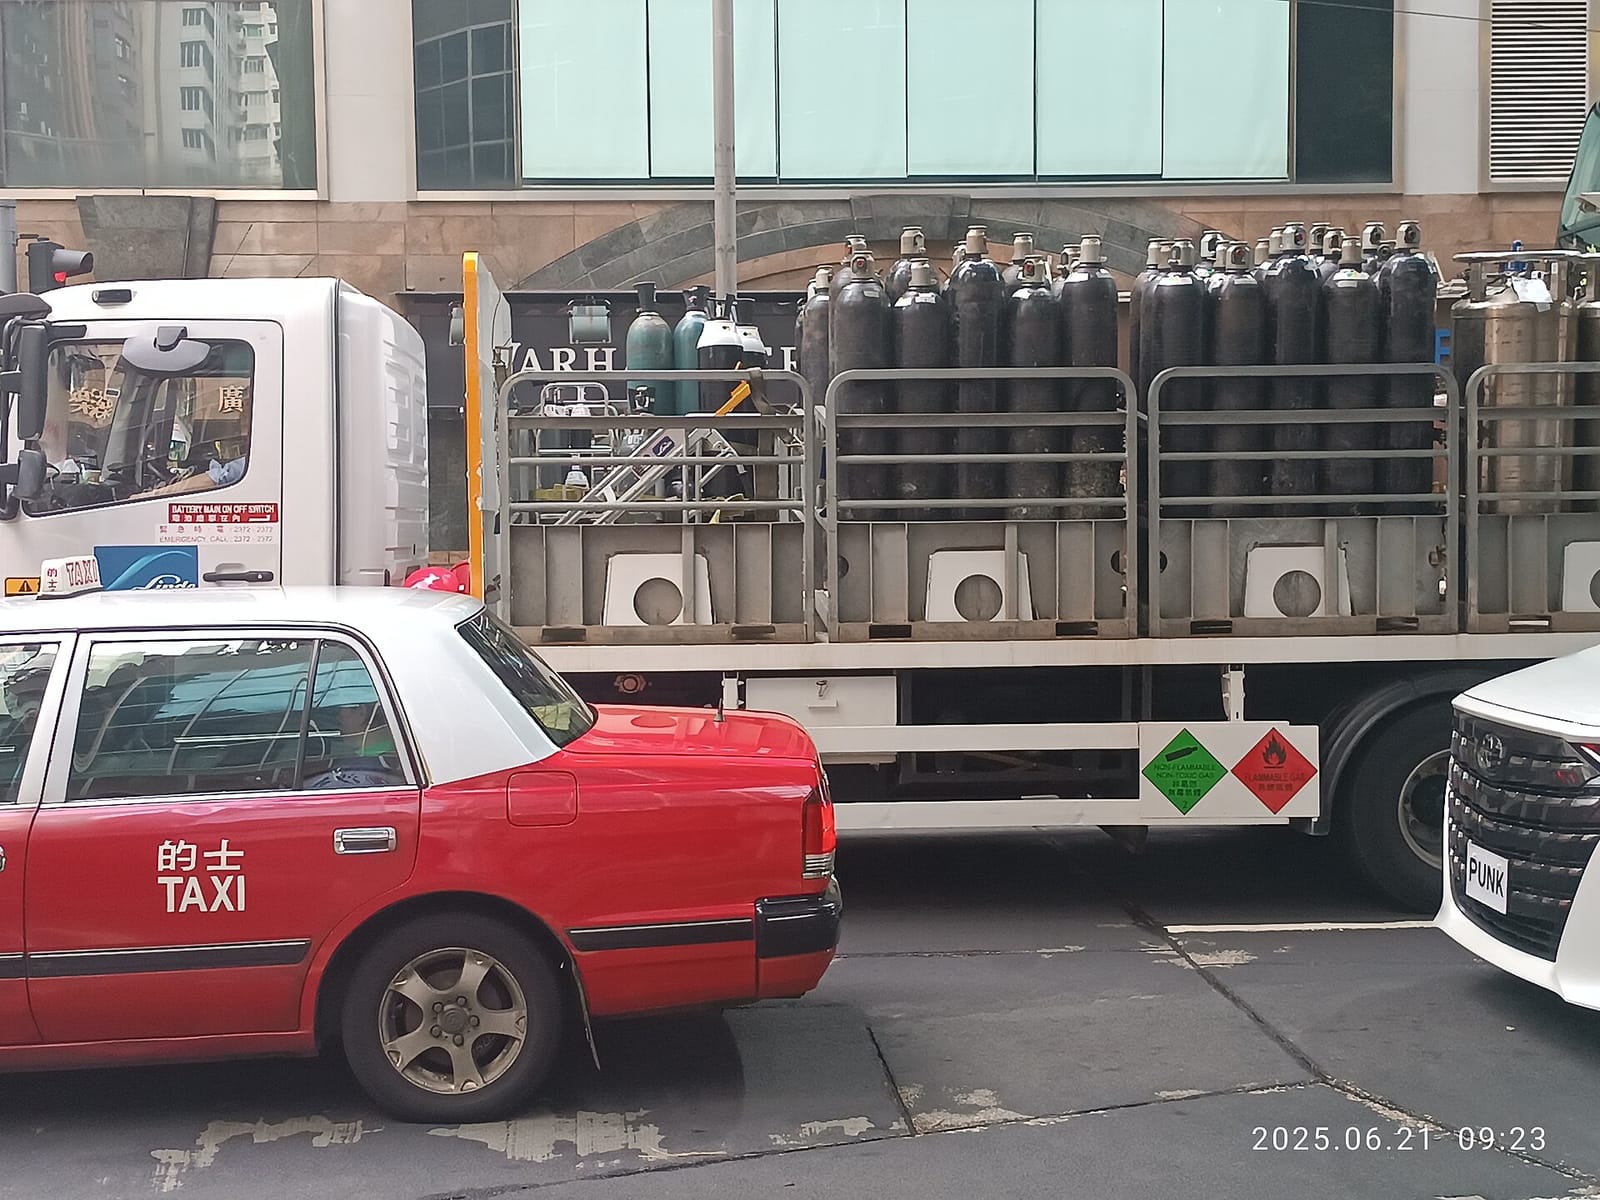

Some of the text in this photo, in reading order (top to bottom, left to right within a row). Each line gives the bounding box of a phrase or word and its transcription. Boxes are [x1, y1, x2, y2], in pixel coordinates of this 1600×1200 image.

[218, 385, 245, 412] 廣
[172, 504, 202, 514] BATTERY
[203, 504, 220, 514] MAIN
[233, 504, 247, 514] OFF
[248, 504, 274, 514] SWITCH
[65, 558, 98, 586] TAXI
[157, 839, 244, 871] 的士
[1469, 857, 1504, 898] PUNK
[157, 875, 245, 912] TAXI
